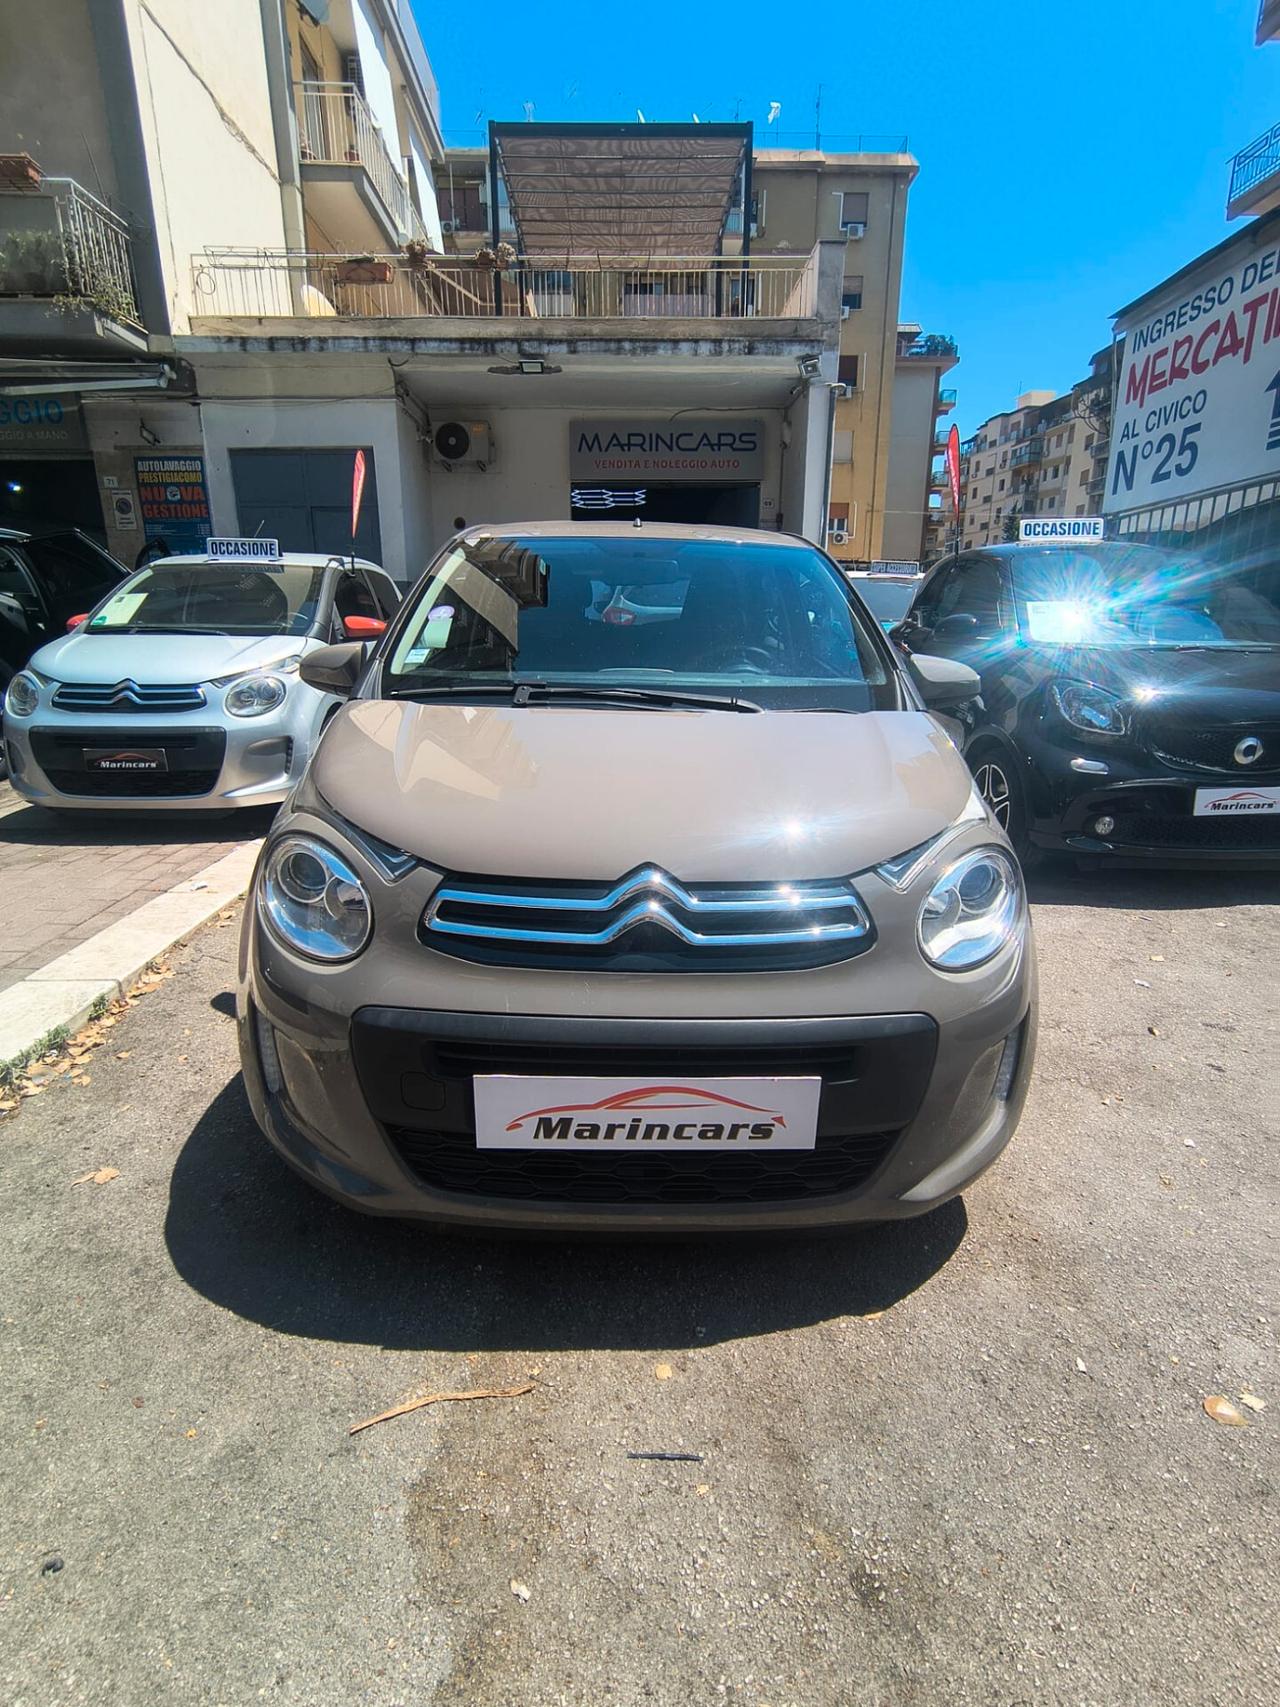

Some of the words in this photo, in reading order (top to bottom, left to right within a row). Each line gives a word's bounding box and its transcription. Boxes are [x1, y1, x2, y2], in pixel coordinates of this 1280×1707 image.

[1132, 276, 1234, 354] INGRESSO
[1119, 420, 1140, 444] AL
[1145, 388, 1208, 434] CIVICO
[577, 432, 757, 453] MARINCARS
[137, 460, 202, 471] AUTOLAVAGGIO
[594, 459, 641, 469] VENDITA
[644, 459, 651, 469] E
[653, 459, 708, 469] NOLEGGIO
[710, 459, 741, 469] AUTO
[138, 471, 203, 483] PRESTIGIACOMO
[143, 503, 209, 518] GESTIONE
[1024, 521, 1100, 536] OCCASIONE
[210, 541, 276, 556] OCCASIONE
[1210, 801, 1275, 811] Marincars
[532, 1116, 776, 1142] Marincars
